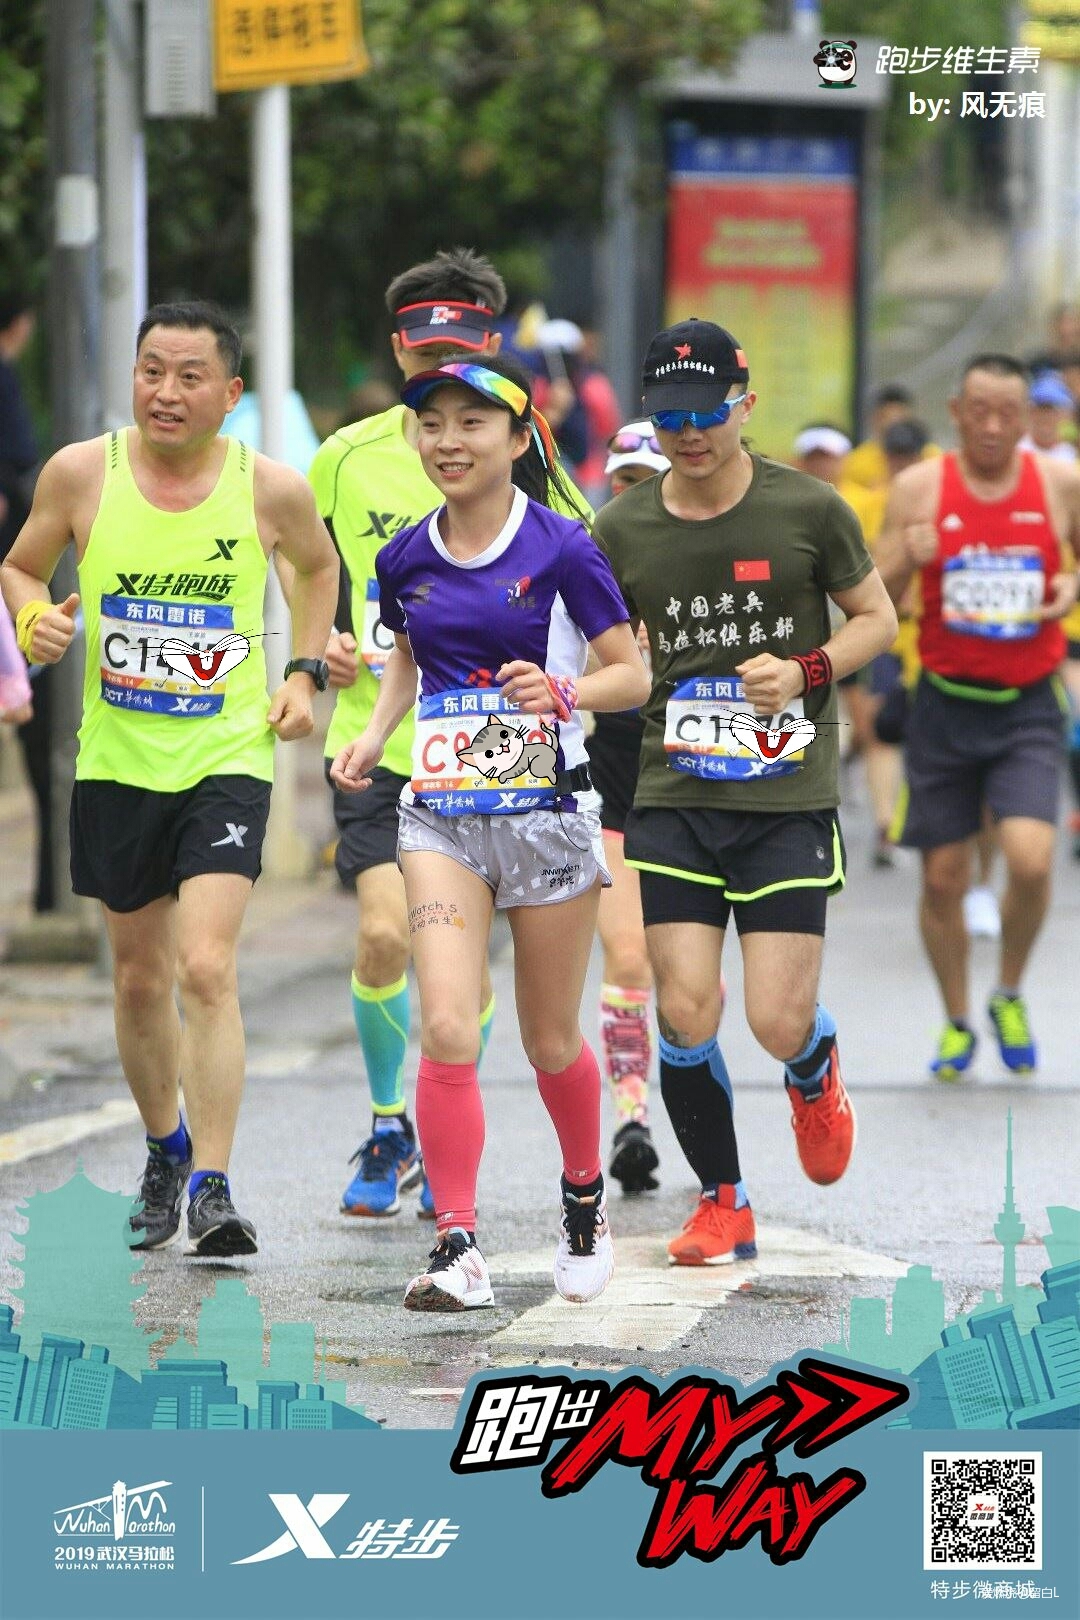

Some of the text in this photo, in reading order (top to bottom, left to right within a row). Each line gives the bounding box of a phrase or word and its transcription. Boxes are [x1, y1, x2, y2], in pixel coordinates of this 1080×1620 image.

[125, 602, 206, 625] 东风雷诺
[664, 590, 765, 625] 中国老兵
[657, 615, 795, 654] 马拉松俱乐部
